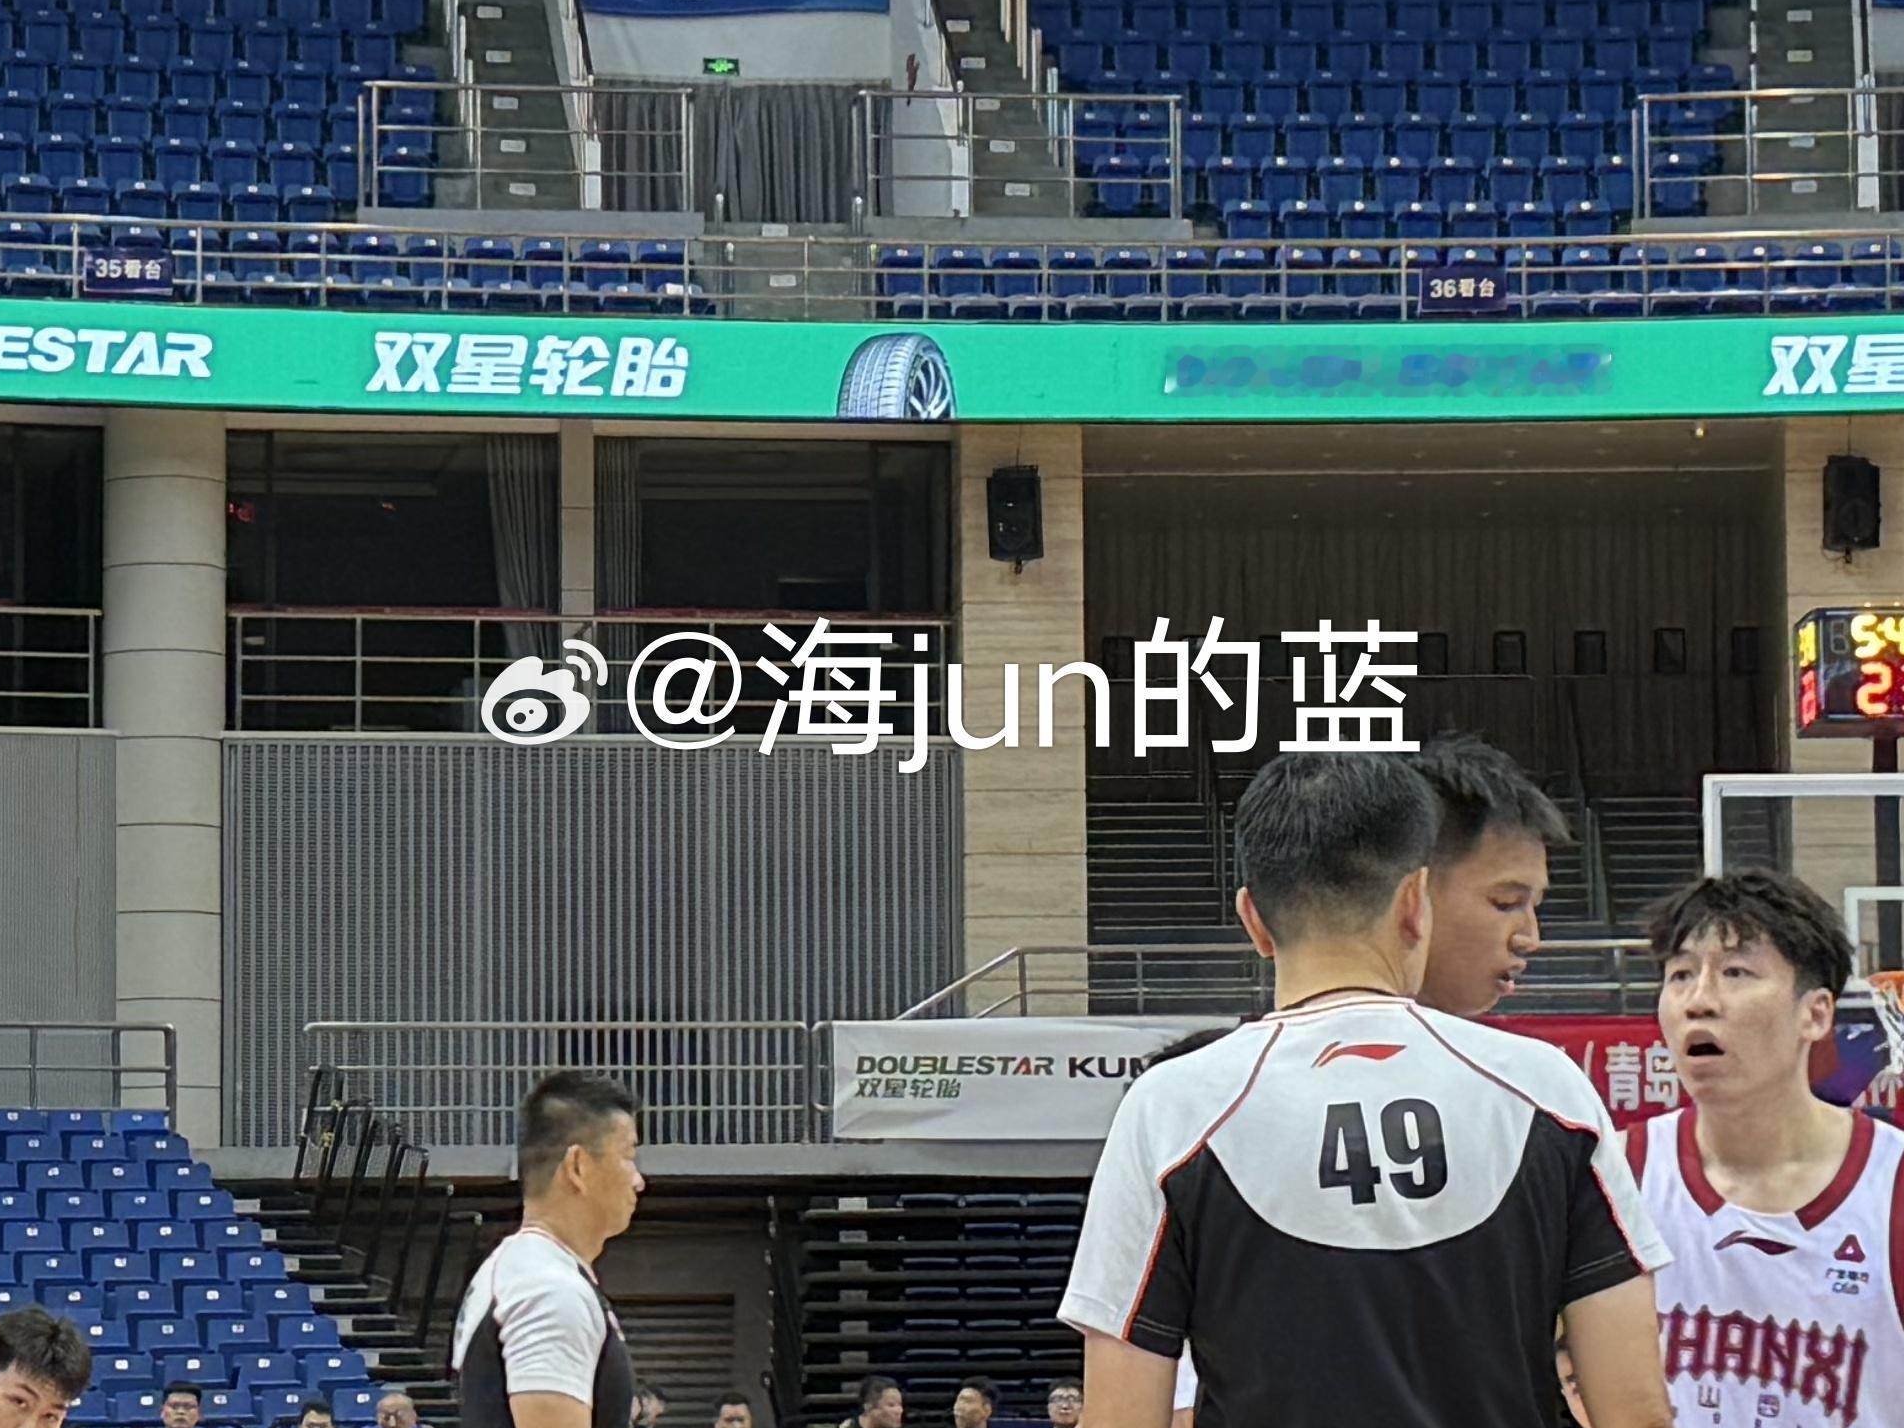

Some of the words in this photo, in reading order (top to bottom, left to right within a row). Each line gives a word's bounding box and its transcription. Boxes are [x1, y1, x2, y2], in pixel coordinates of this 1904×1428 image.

[366, 331, 690, 398] 双星轮胎
[855, 1078, 961, 1099] 双星轮胎
[856, 1056, 1054, 1076] DOUBLESTAR
[1318, 1098, 1448, 1205] 49
[1657, 1302, 1869, 1428] HANXI
